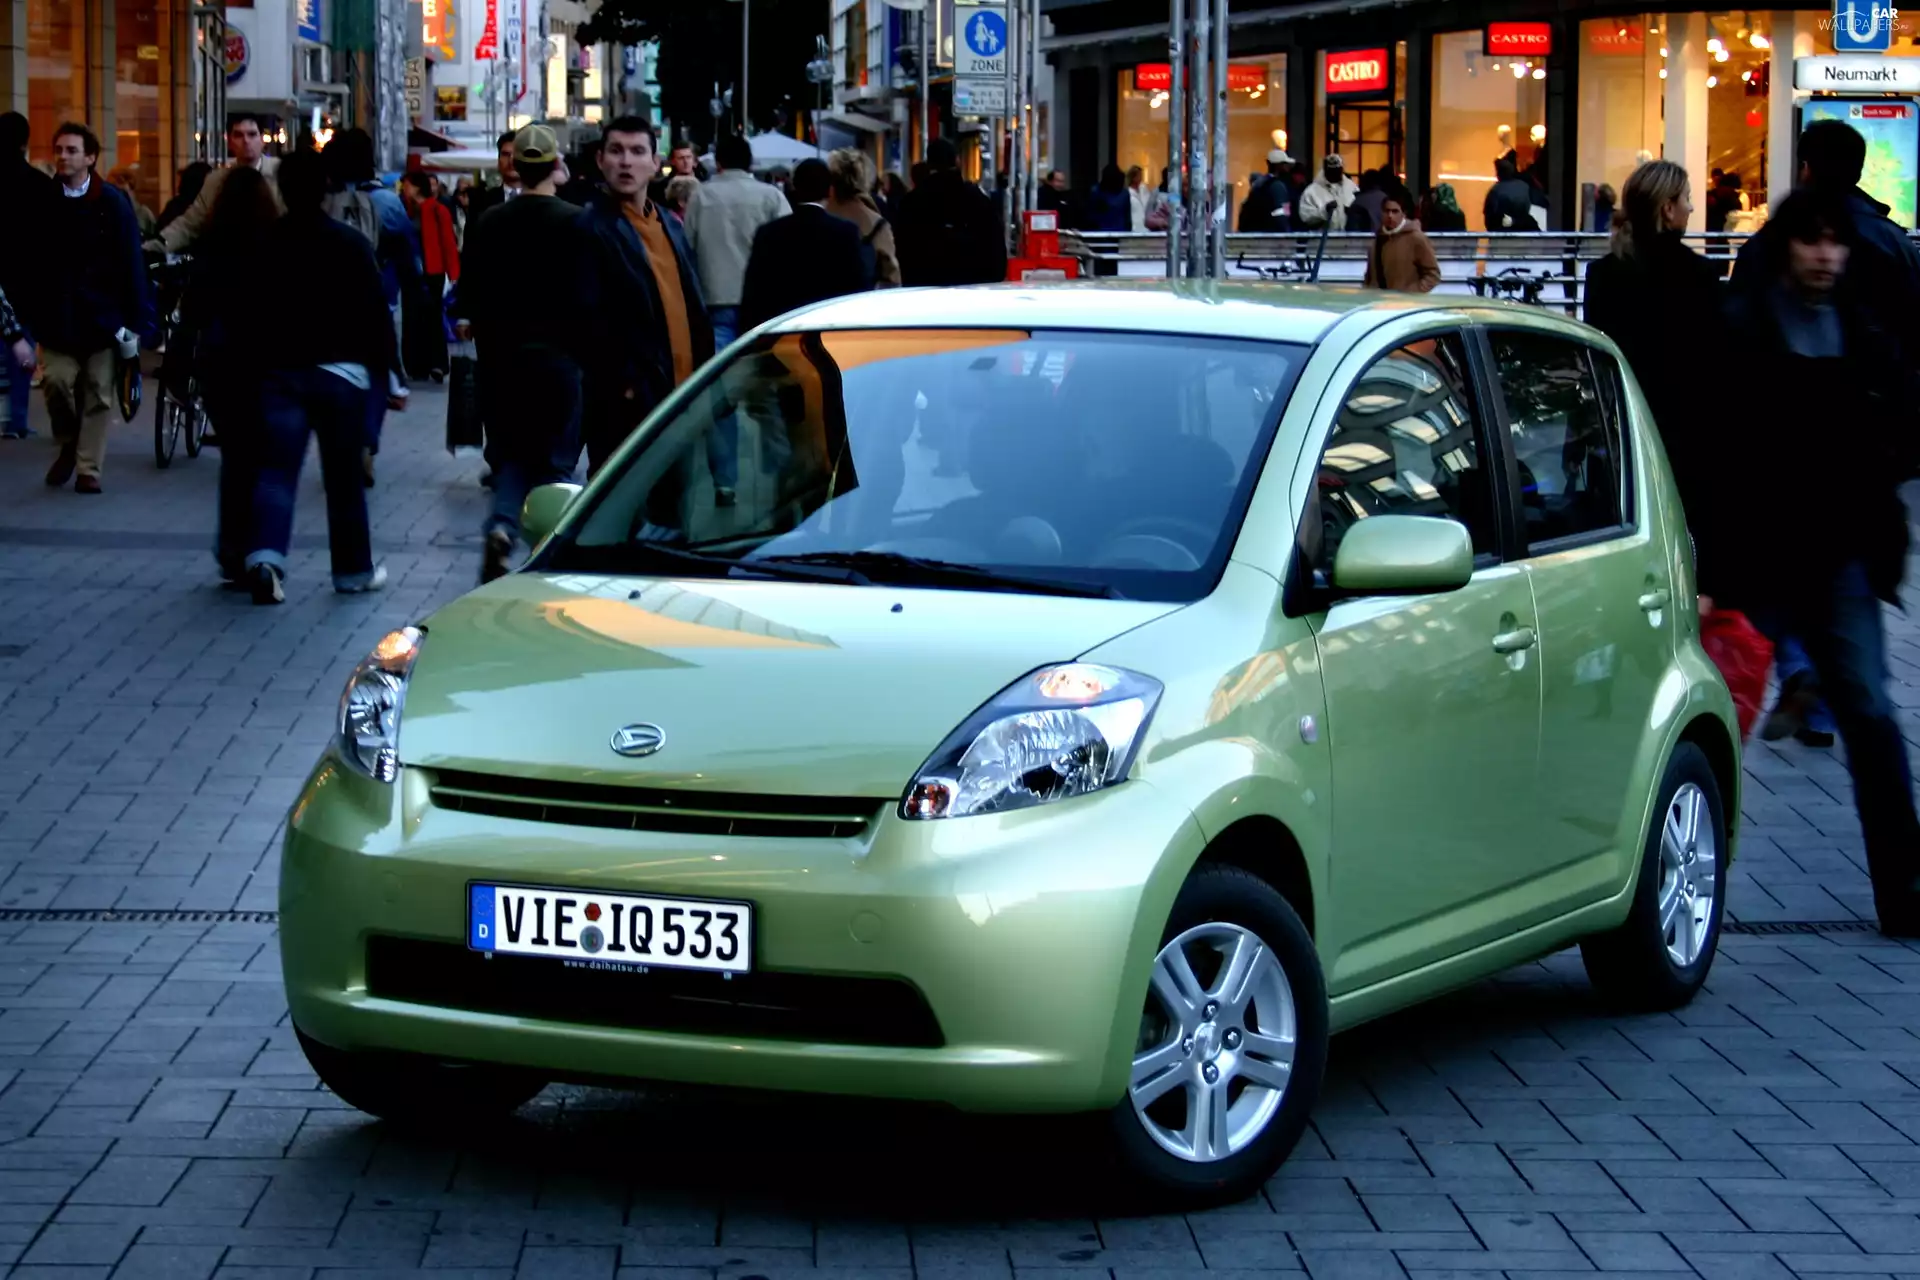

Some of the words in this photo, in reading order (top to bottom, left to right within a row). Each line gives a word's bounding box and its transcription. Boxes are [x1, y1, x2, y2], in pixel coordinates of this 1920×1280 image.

[1491, 34, 1548, 44] CASTRO
[970, 59, 1003, 71] ZONE
[1328, 60, 1380, 83] CASTRO
[1824, 65, 1898, 81] Neumarkt
[478, 924, 488, 938] D
[502, 895, 577, 948] VIE
[662, 907, 739, 961] 533
[563, 960, 649, 974] www.daihatsu.de
